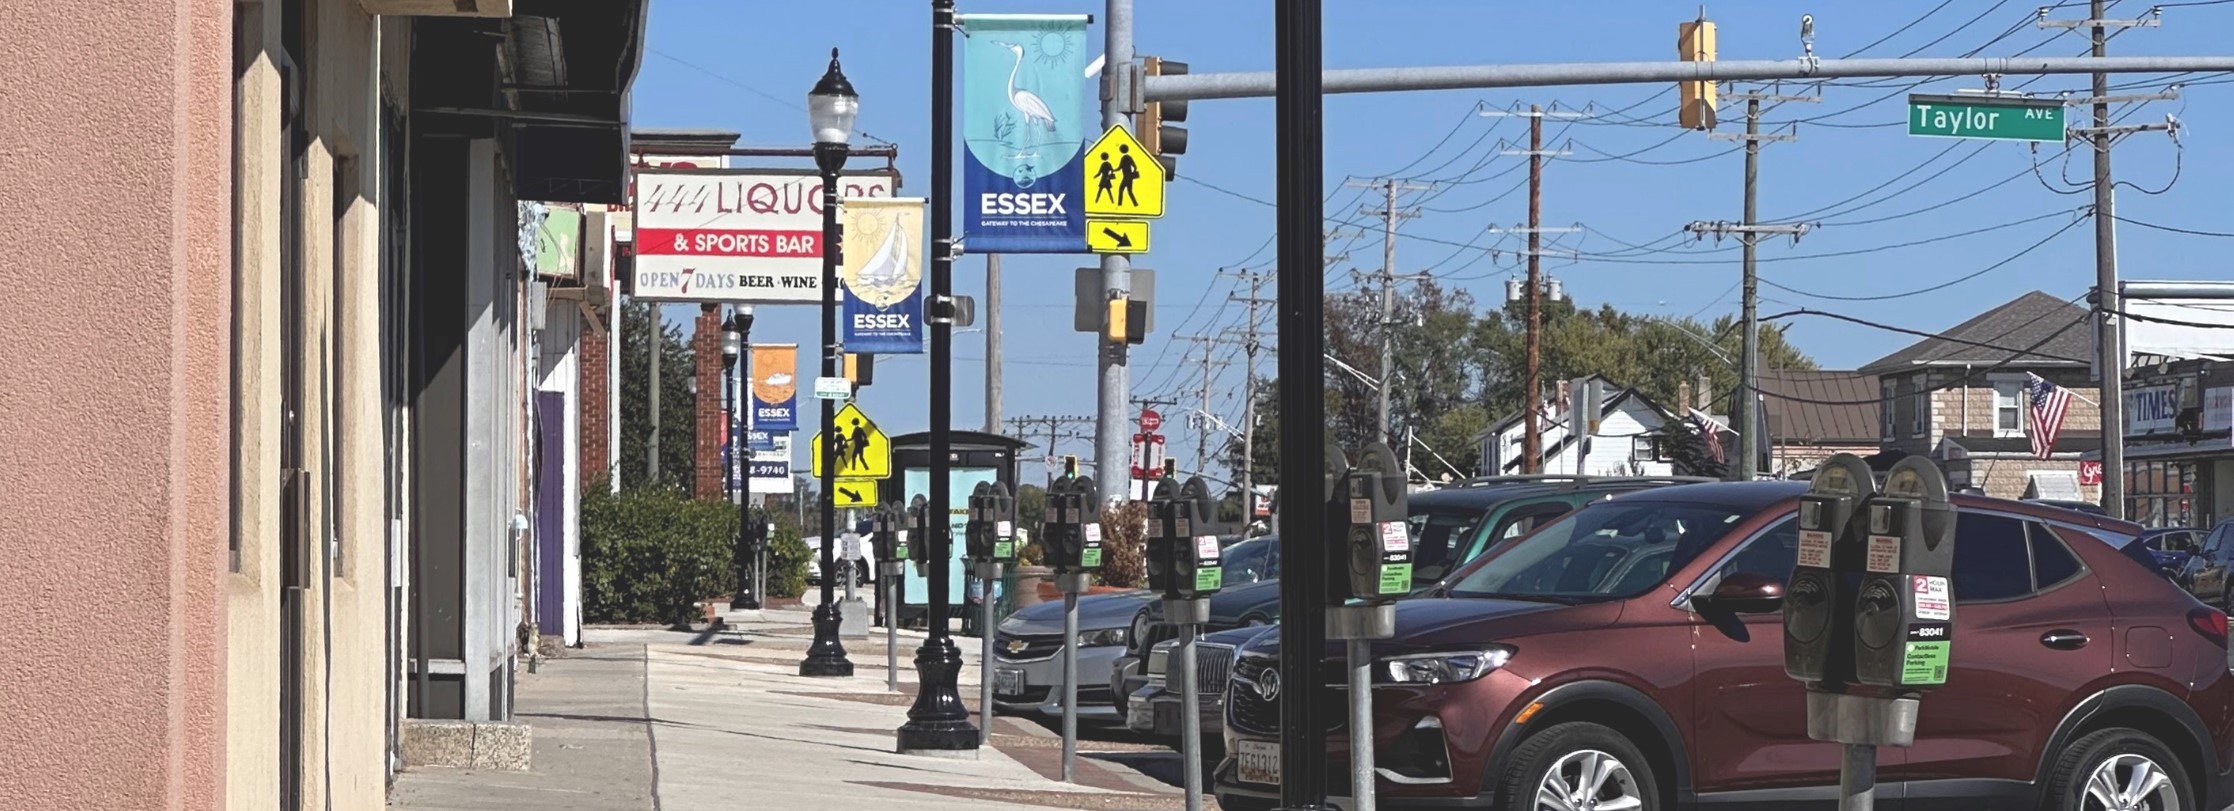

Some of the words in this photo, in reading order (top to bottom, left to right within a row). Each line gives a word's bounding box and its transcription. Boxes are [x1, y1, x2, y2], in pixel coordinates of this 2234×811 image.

[1917, 105, 1999, 134] Taylor
[2025, 108, 2053, 120] AVE
[644, 183, 710, 213] 444
[981, 192, 1066, 215] ESSEX
[673, 233, 690, 251] &
[695, 233, 769, 253] SPORTS
[776, 235, 814, 254] BAR
[640, 272, 679, 287] OPEN
[681, 267, 696, 294] 7
[696, 273, 735, 288] DAYS
[739, 275, 774, 288] BEER
[781, 276, 817, 289] WINE
[854, 313, 910, 328] ESSEX
[758, 408, 790, 417] ESSEX
[2136, 390, 2176, 421] TIMES
[1916, 578, 1928, 592] 2
[1919, 627, 1943, 636] 83041
